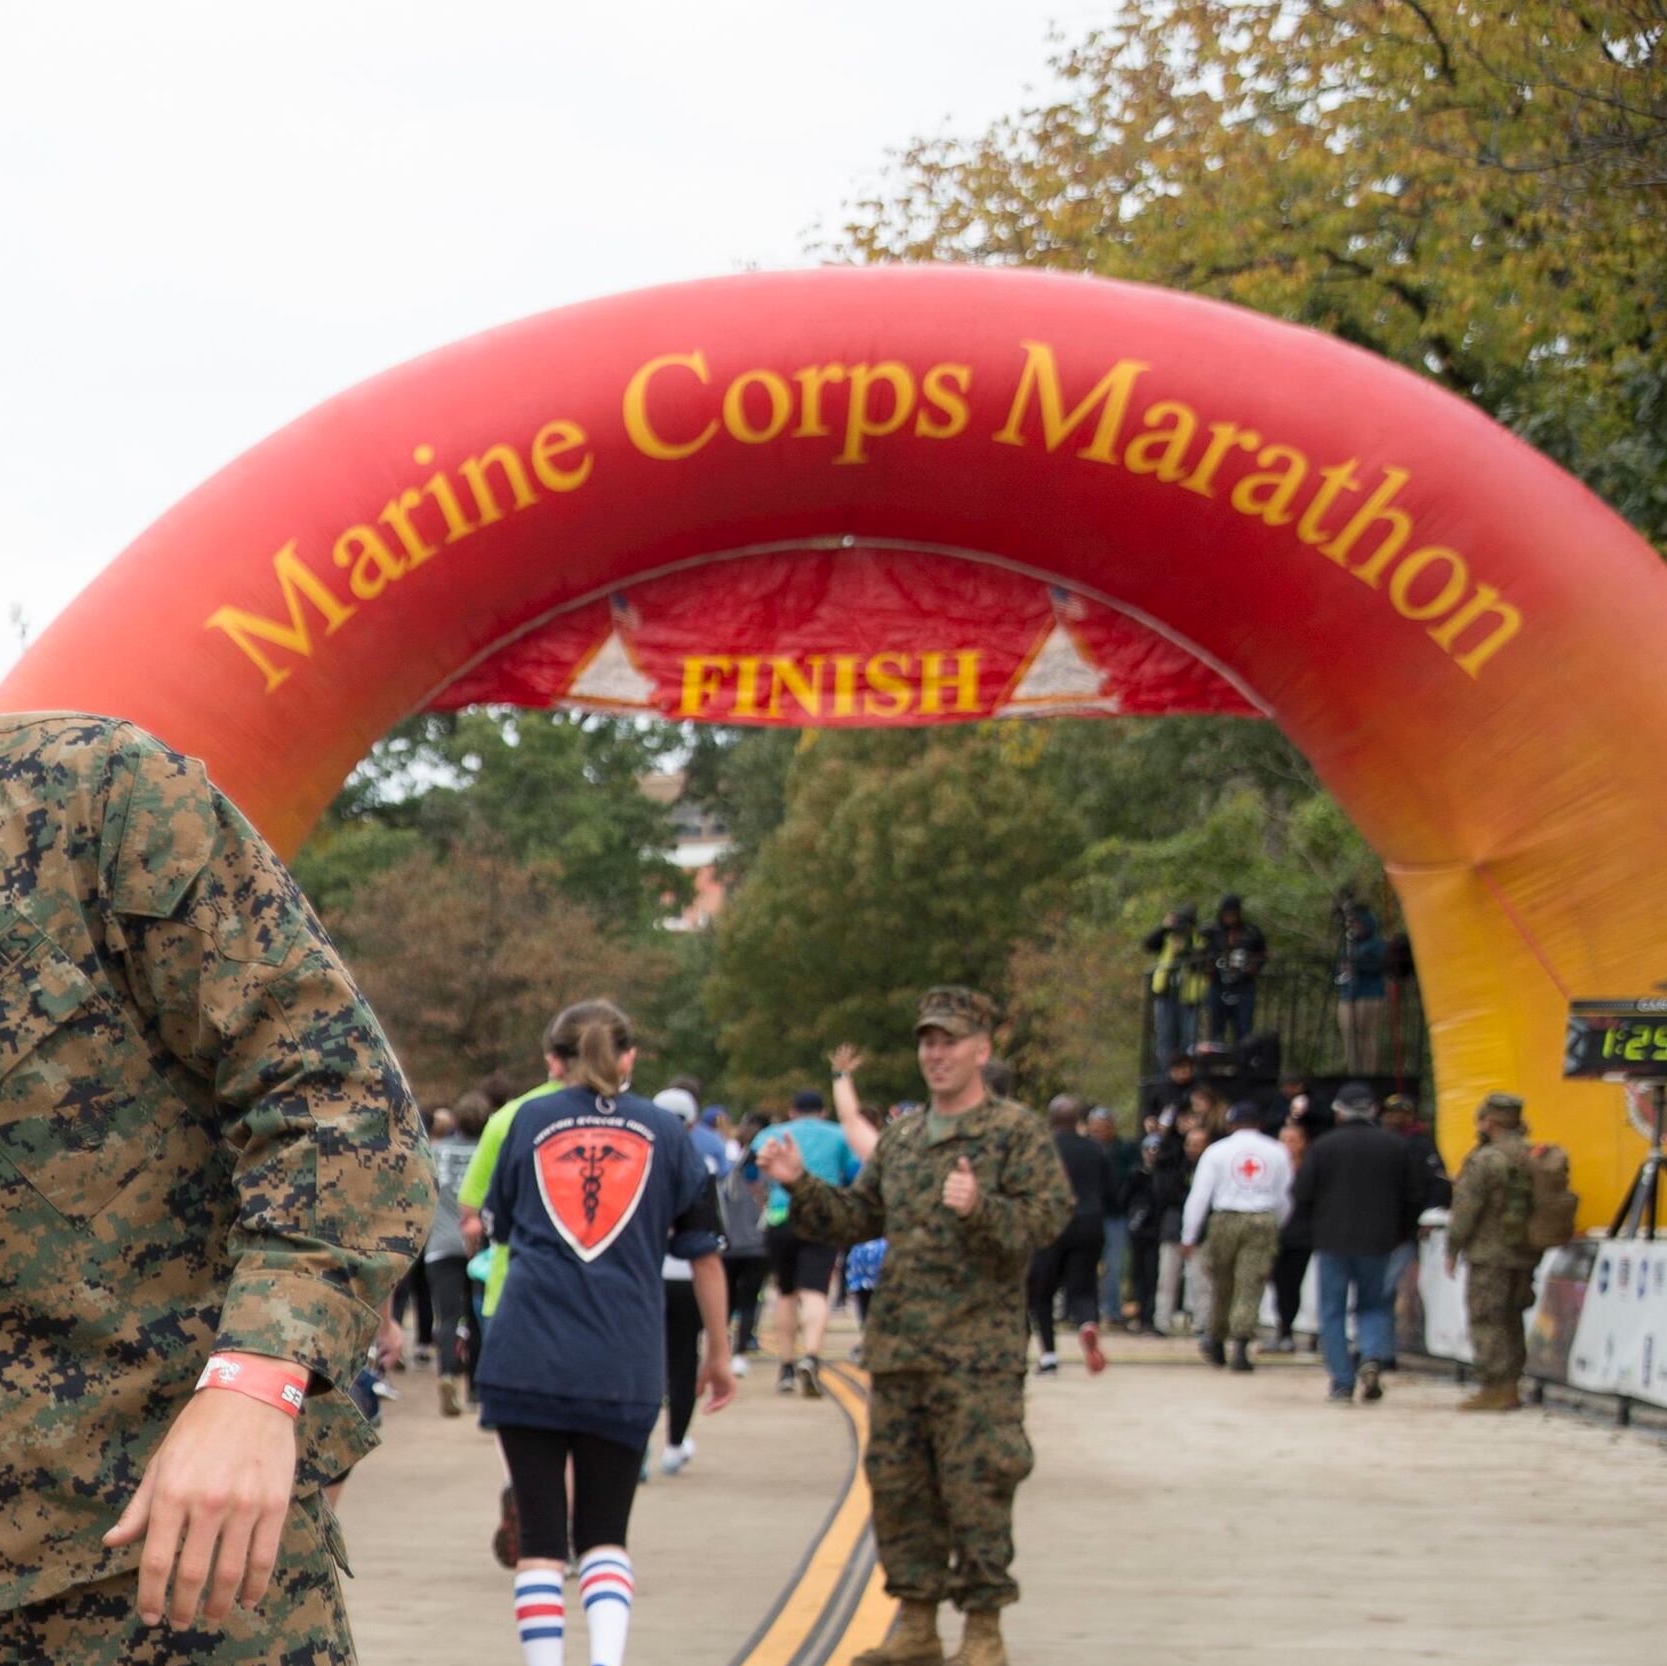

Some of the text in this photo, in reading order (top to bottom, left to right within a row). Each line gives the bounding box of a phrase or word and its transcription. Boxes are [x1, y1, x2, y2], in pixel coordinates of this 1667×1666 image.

[205, 340, 1525, 694] Marine Corps Marathon
[676, 650, 983, 718] FINISH
